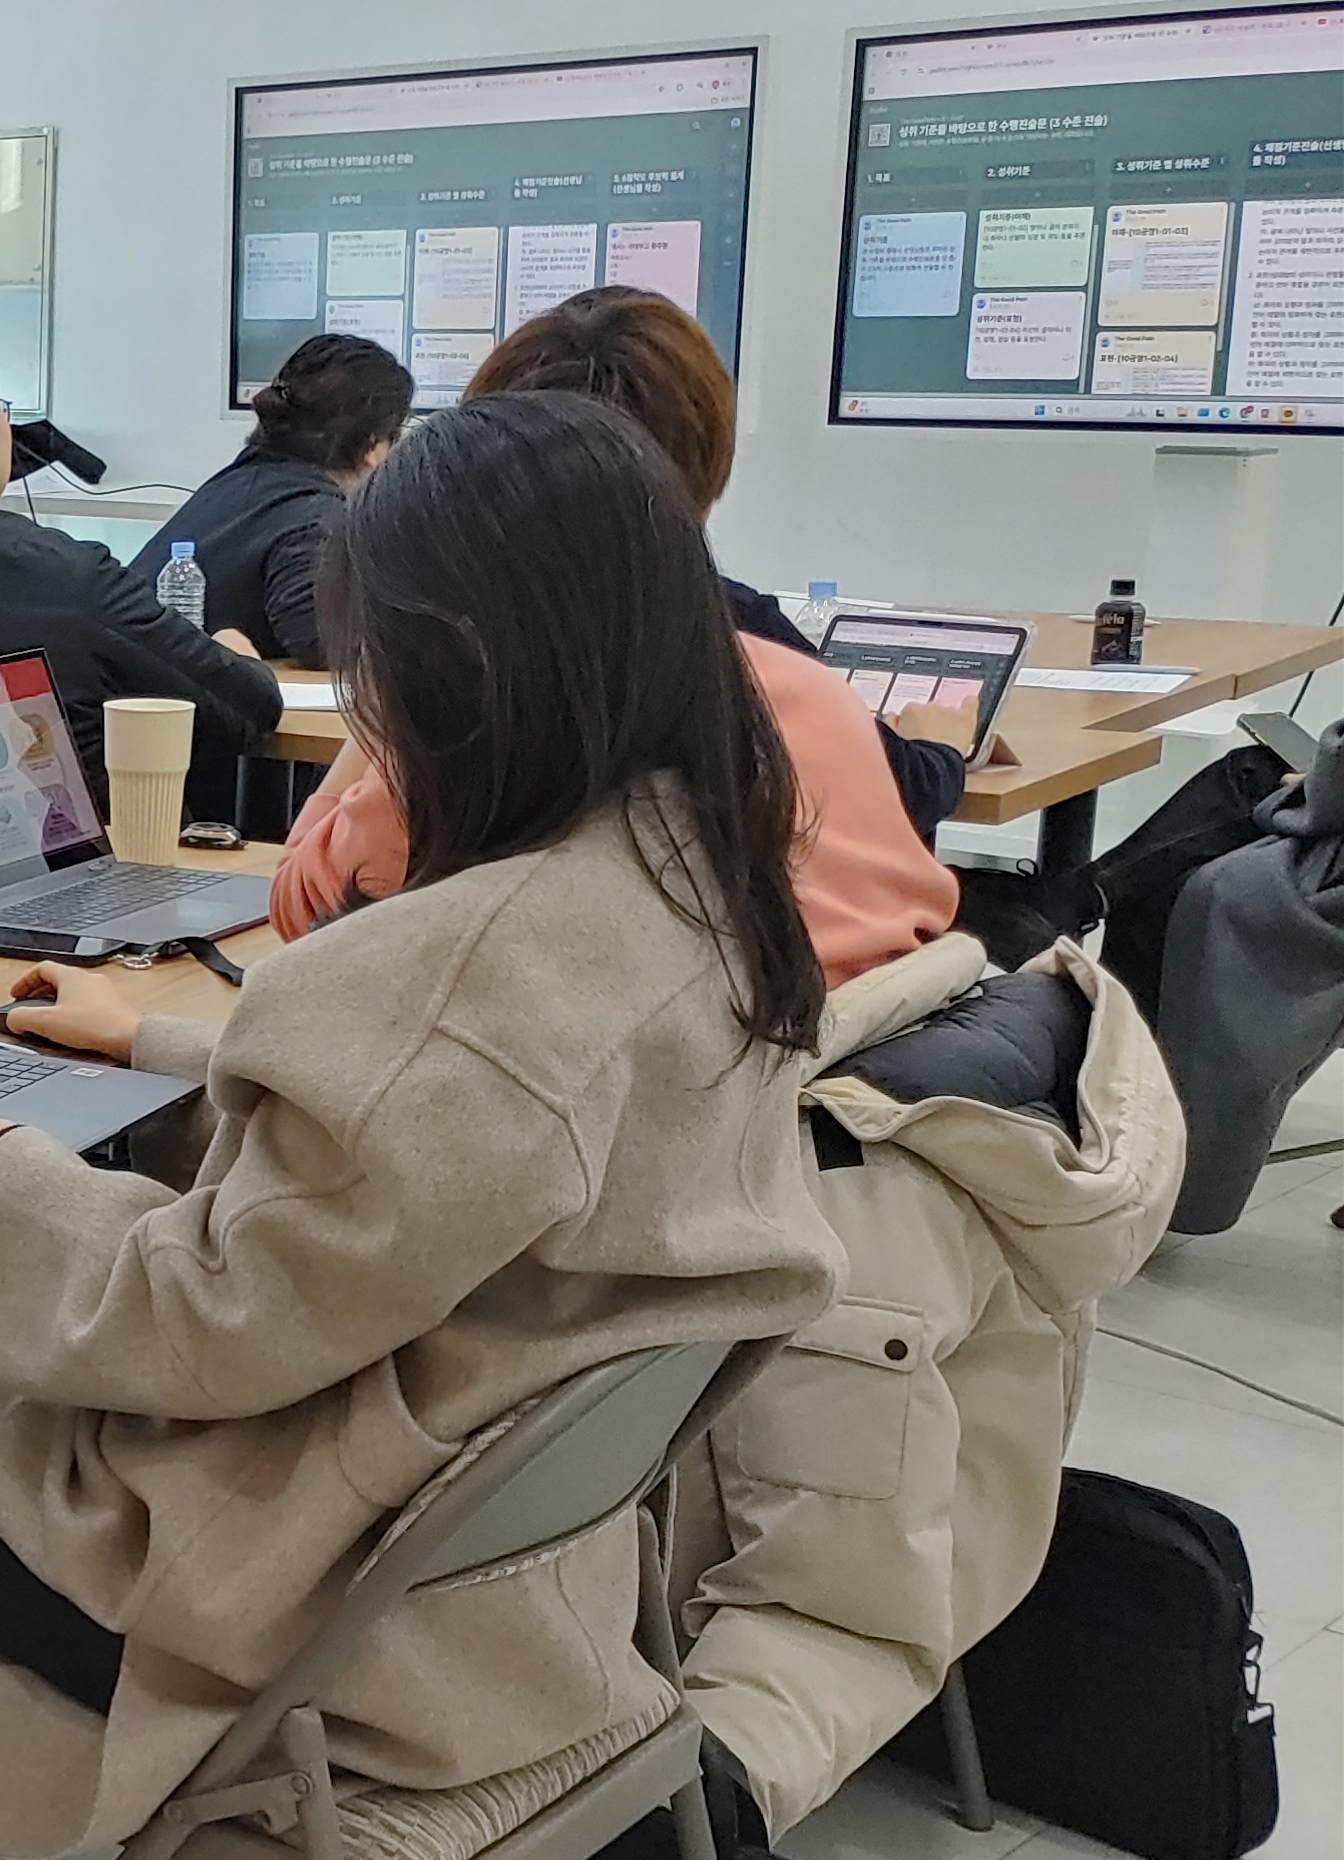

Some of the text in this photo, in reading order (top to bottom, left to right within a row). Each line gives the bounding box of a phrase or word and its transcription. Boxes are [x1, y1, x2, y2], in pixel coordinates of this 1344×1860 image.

[899, 124, 918, 138] 성취
[948, 121, 986, 135] 바탕으로
[987, 120, 998, 133] 한
[1062, 116, 1082, 129] 수준
[1264, 139, 1344, 153] 채점기준진술(선생
